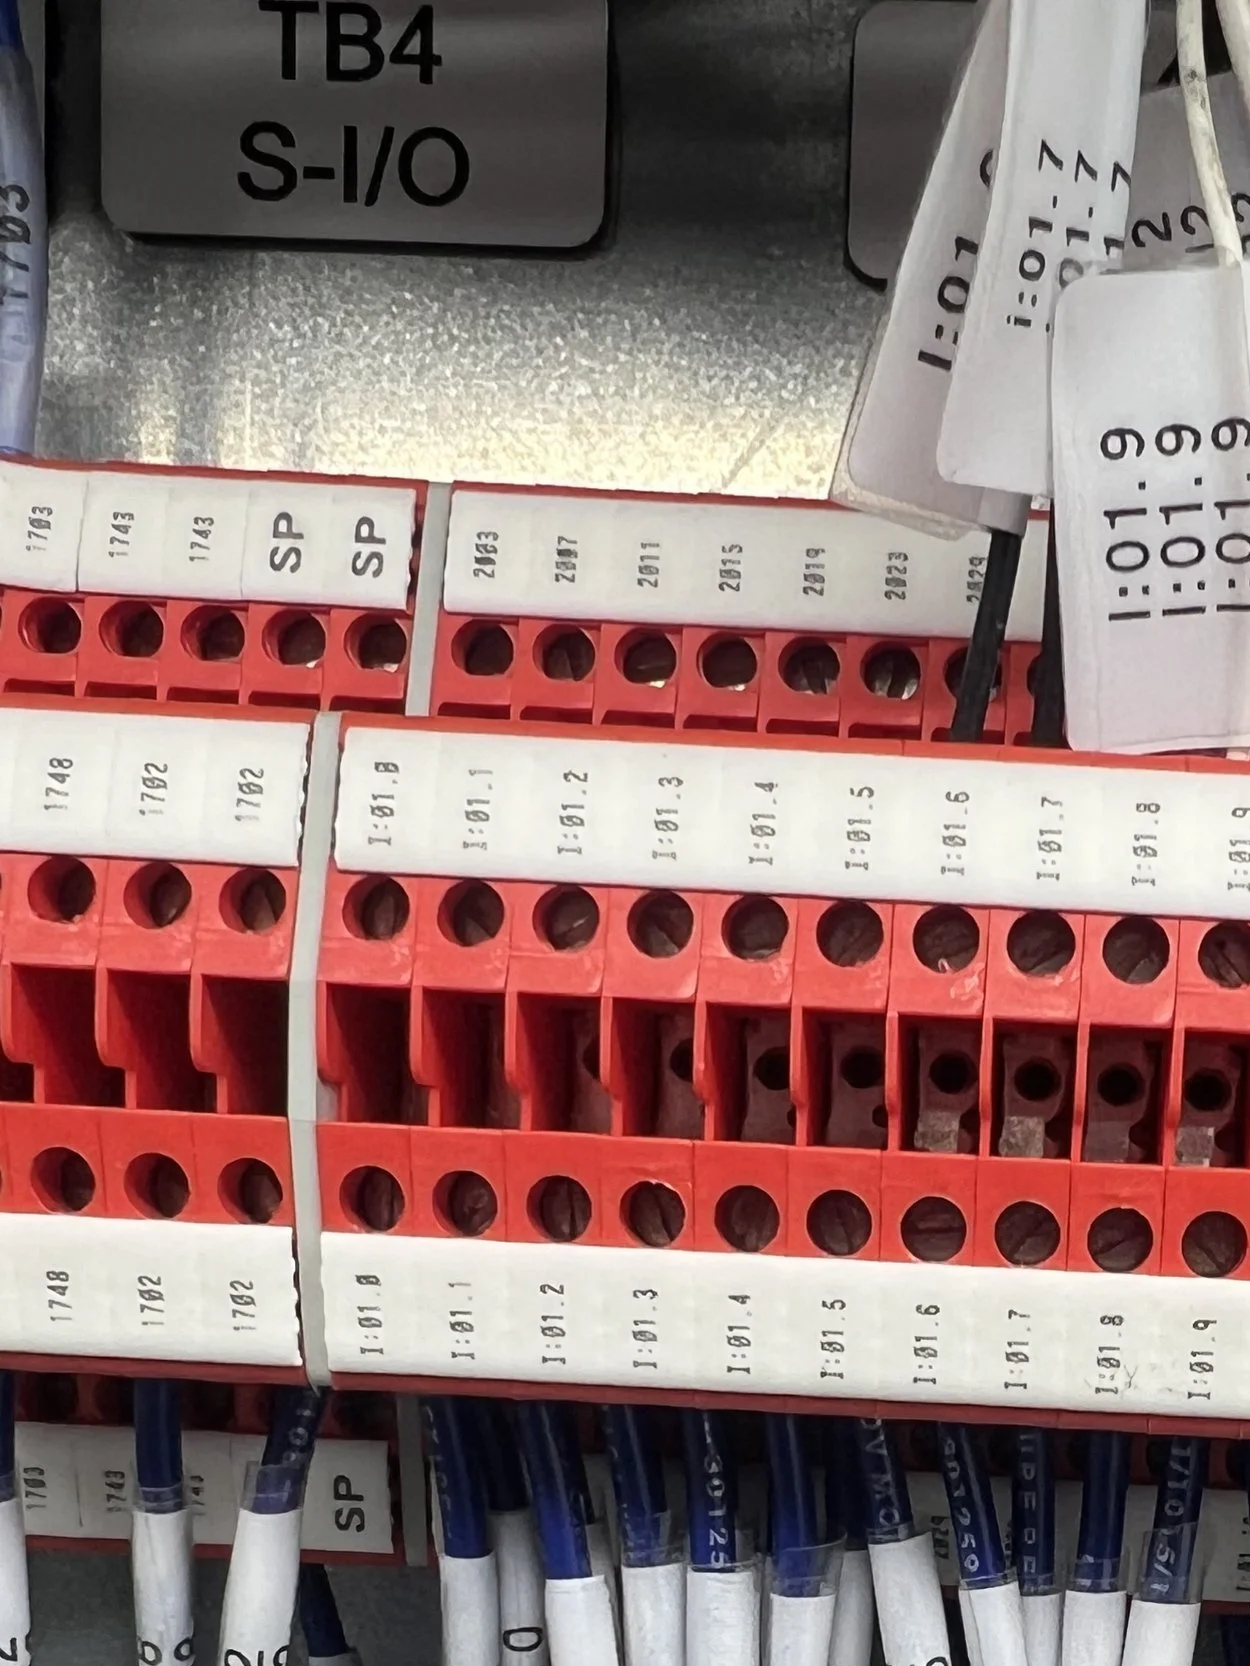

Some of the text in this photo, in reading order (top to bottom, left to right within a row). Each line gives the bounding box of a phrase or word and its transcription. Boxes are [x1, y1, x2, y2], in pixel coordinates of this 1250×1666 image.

[258, 0, 443, 85] TB4
[237, 120, 470, 206] S-I/O
[269, 511, 304, 574] SP
[351, 516, 387, 578] SP
[1100, 427, 1151, 621] I:01.9
[1155, 424, 1206, 616] I:01.9
[46, 1269, 71, 1323] 1748
[539, 1282, 567, 1366] I:01.2
[632, 1288, 659, 1371] I:01.3
[726, 1293, 752, 1376] I:01.4
[819, 1299, 847, 1382] I:01.5
[912, 1303, 942, 1386] I:01.6
[1003, 1308, 1032, 1391] I:01.7
[1186, 1318, 1219, 1401] I:01.9
[332, 1473, 366, 1534] SP
